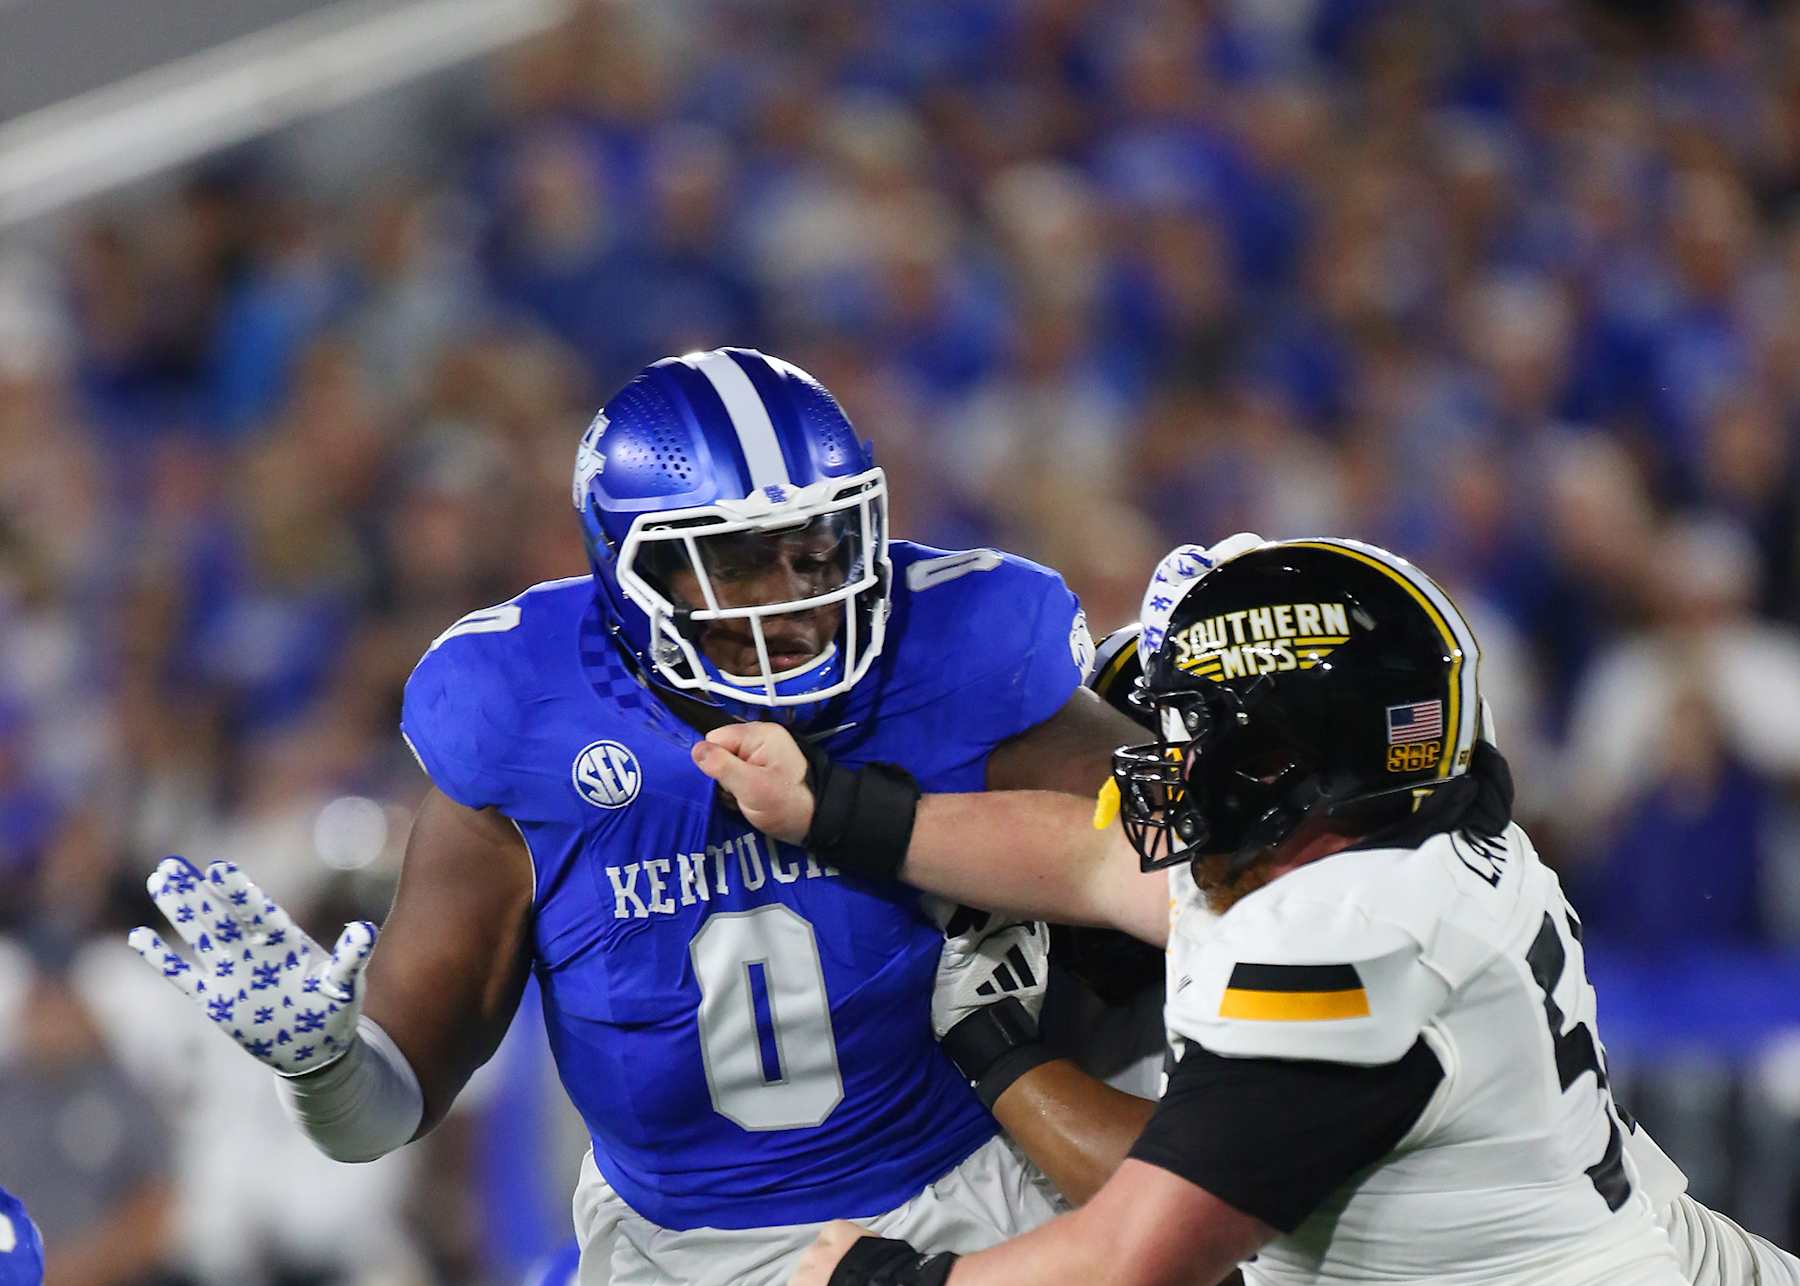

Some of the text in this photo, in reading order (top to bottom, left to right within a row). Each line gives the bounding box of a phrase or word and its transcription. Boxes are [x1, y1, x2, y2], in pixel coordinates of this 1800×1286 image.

[1175, 603, 1350, 662] SOUTHERN
[1220, 639, 1297, 680] MISS
[577, 743, 636, 807] SEC
[606, 832, 840, 919] KENTUC
[689, 902, 845, 1131] 0
